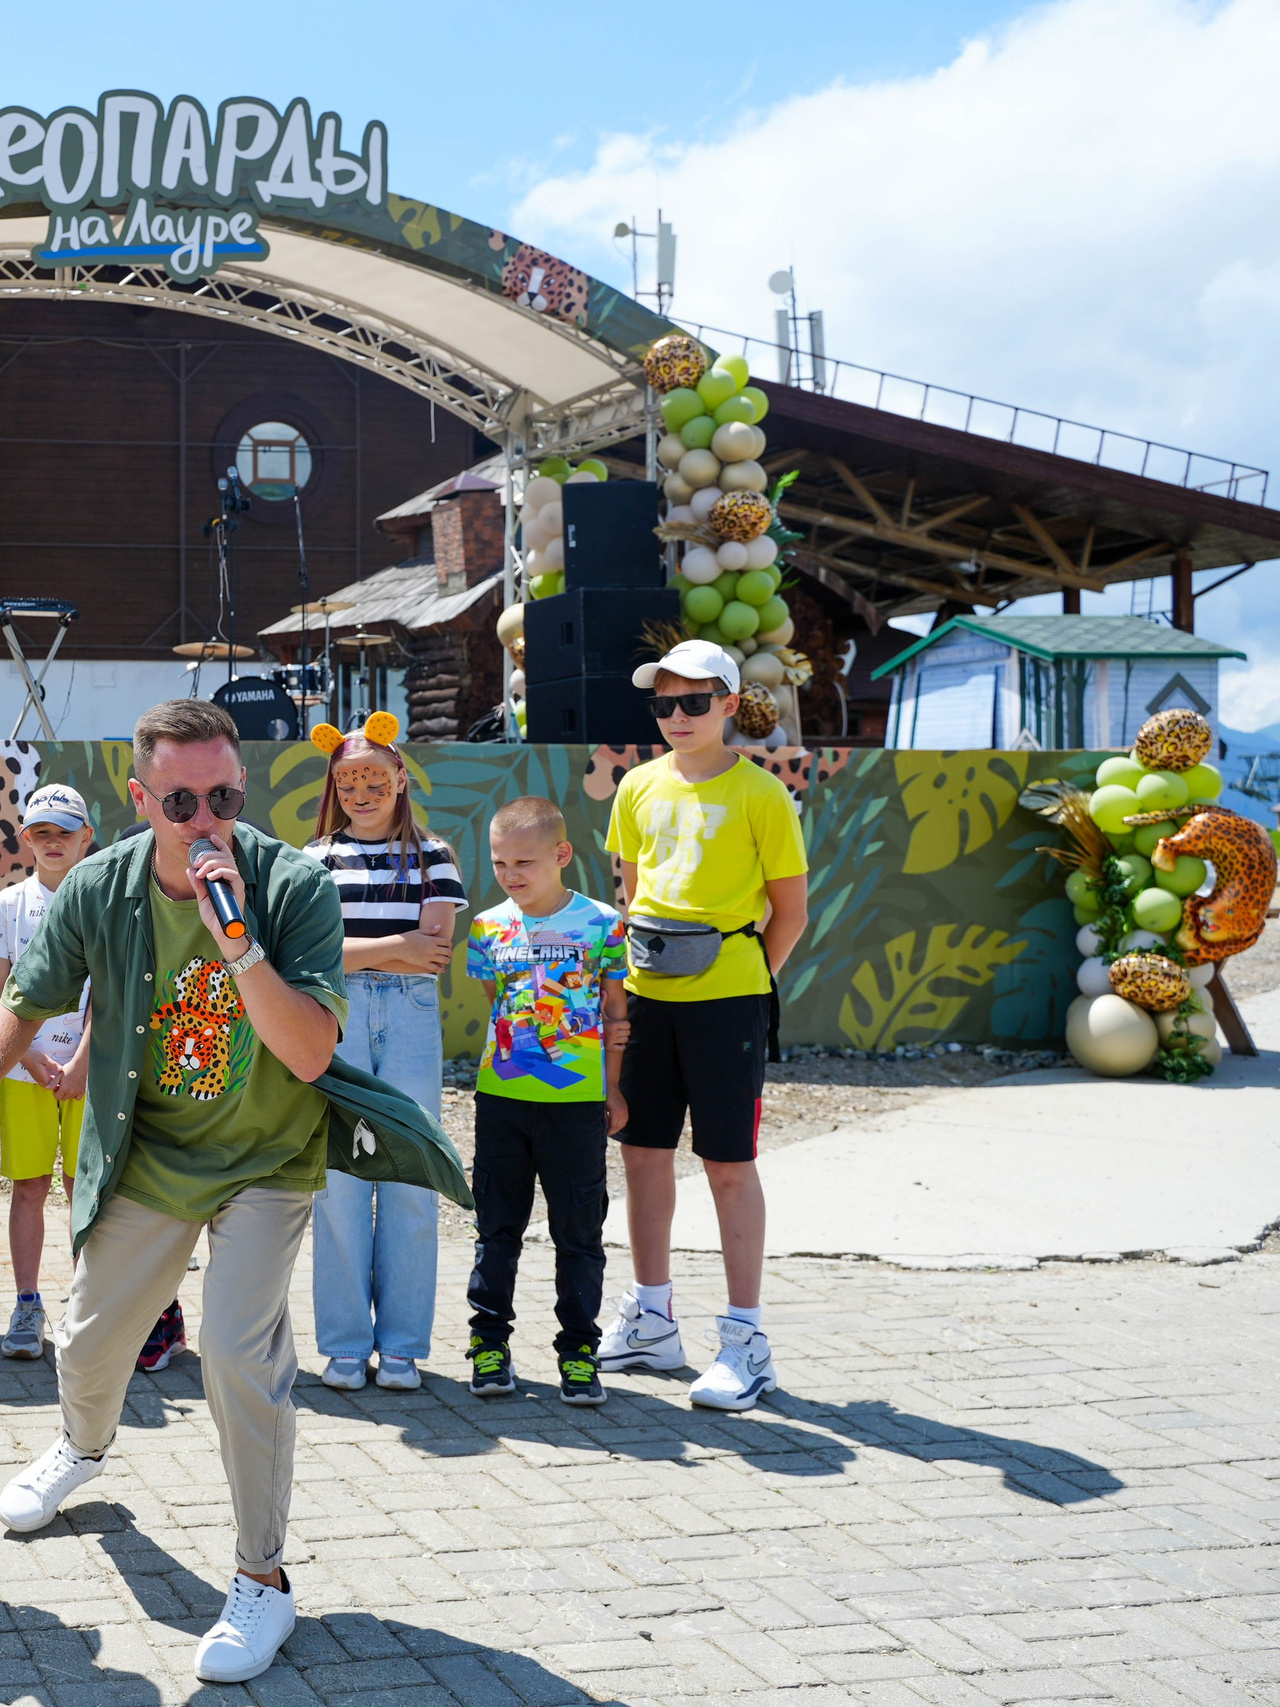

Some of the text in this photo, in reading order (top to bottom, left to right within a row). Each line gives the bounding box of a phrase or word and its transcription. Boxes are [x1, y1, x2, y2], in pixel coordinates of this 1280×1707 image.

[51, 198, 257, 275] на Лауре
[236, 689, 275, 703] YAMAHA
[28, 905, 46, 917] nik
[491, 944, 586, 964] MINECRAFT
[51, 1031, 74, 1045] nike
[721, 1321, 746, 1337] NIKE
